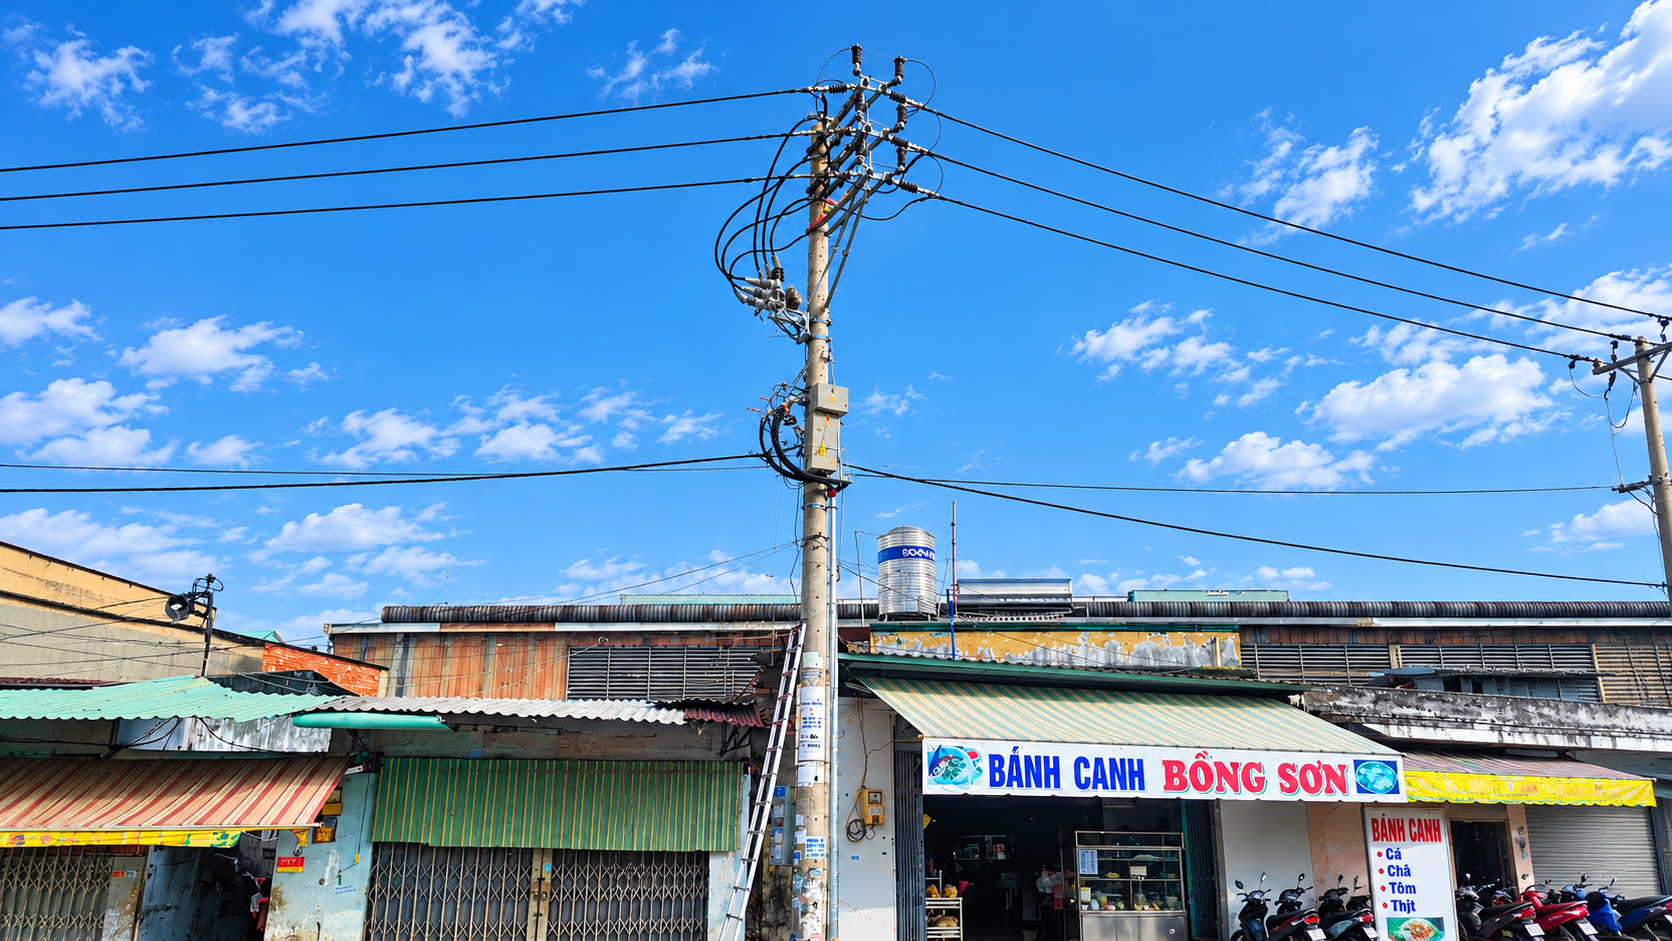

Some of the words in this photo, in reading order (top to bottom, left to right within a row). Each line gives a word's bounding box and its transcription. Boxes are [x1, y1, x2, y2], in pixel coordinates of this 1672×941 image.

[1073, 755, 1146, 791] CANH
[1162, 751, 1267, 794] BỒNG
[1278, 760, 1348, 795] SƠN
[1408, 818, 1442, 843] CANH
[1385, 847, 1402, 860] Cá
[1388, 881, 1417, 894] Tôm
